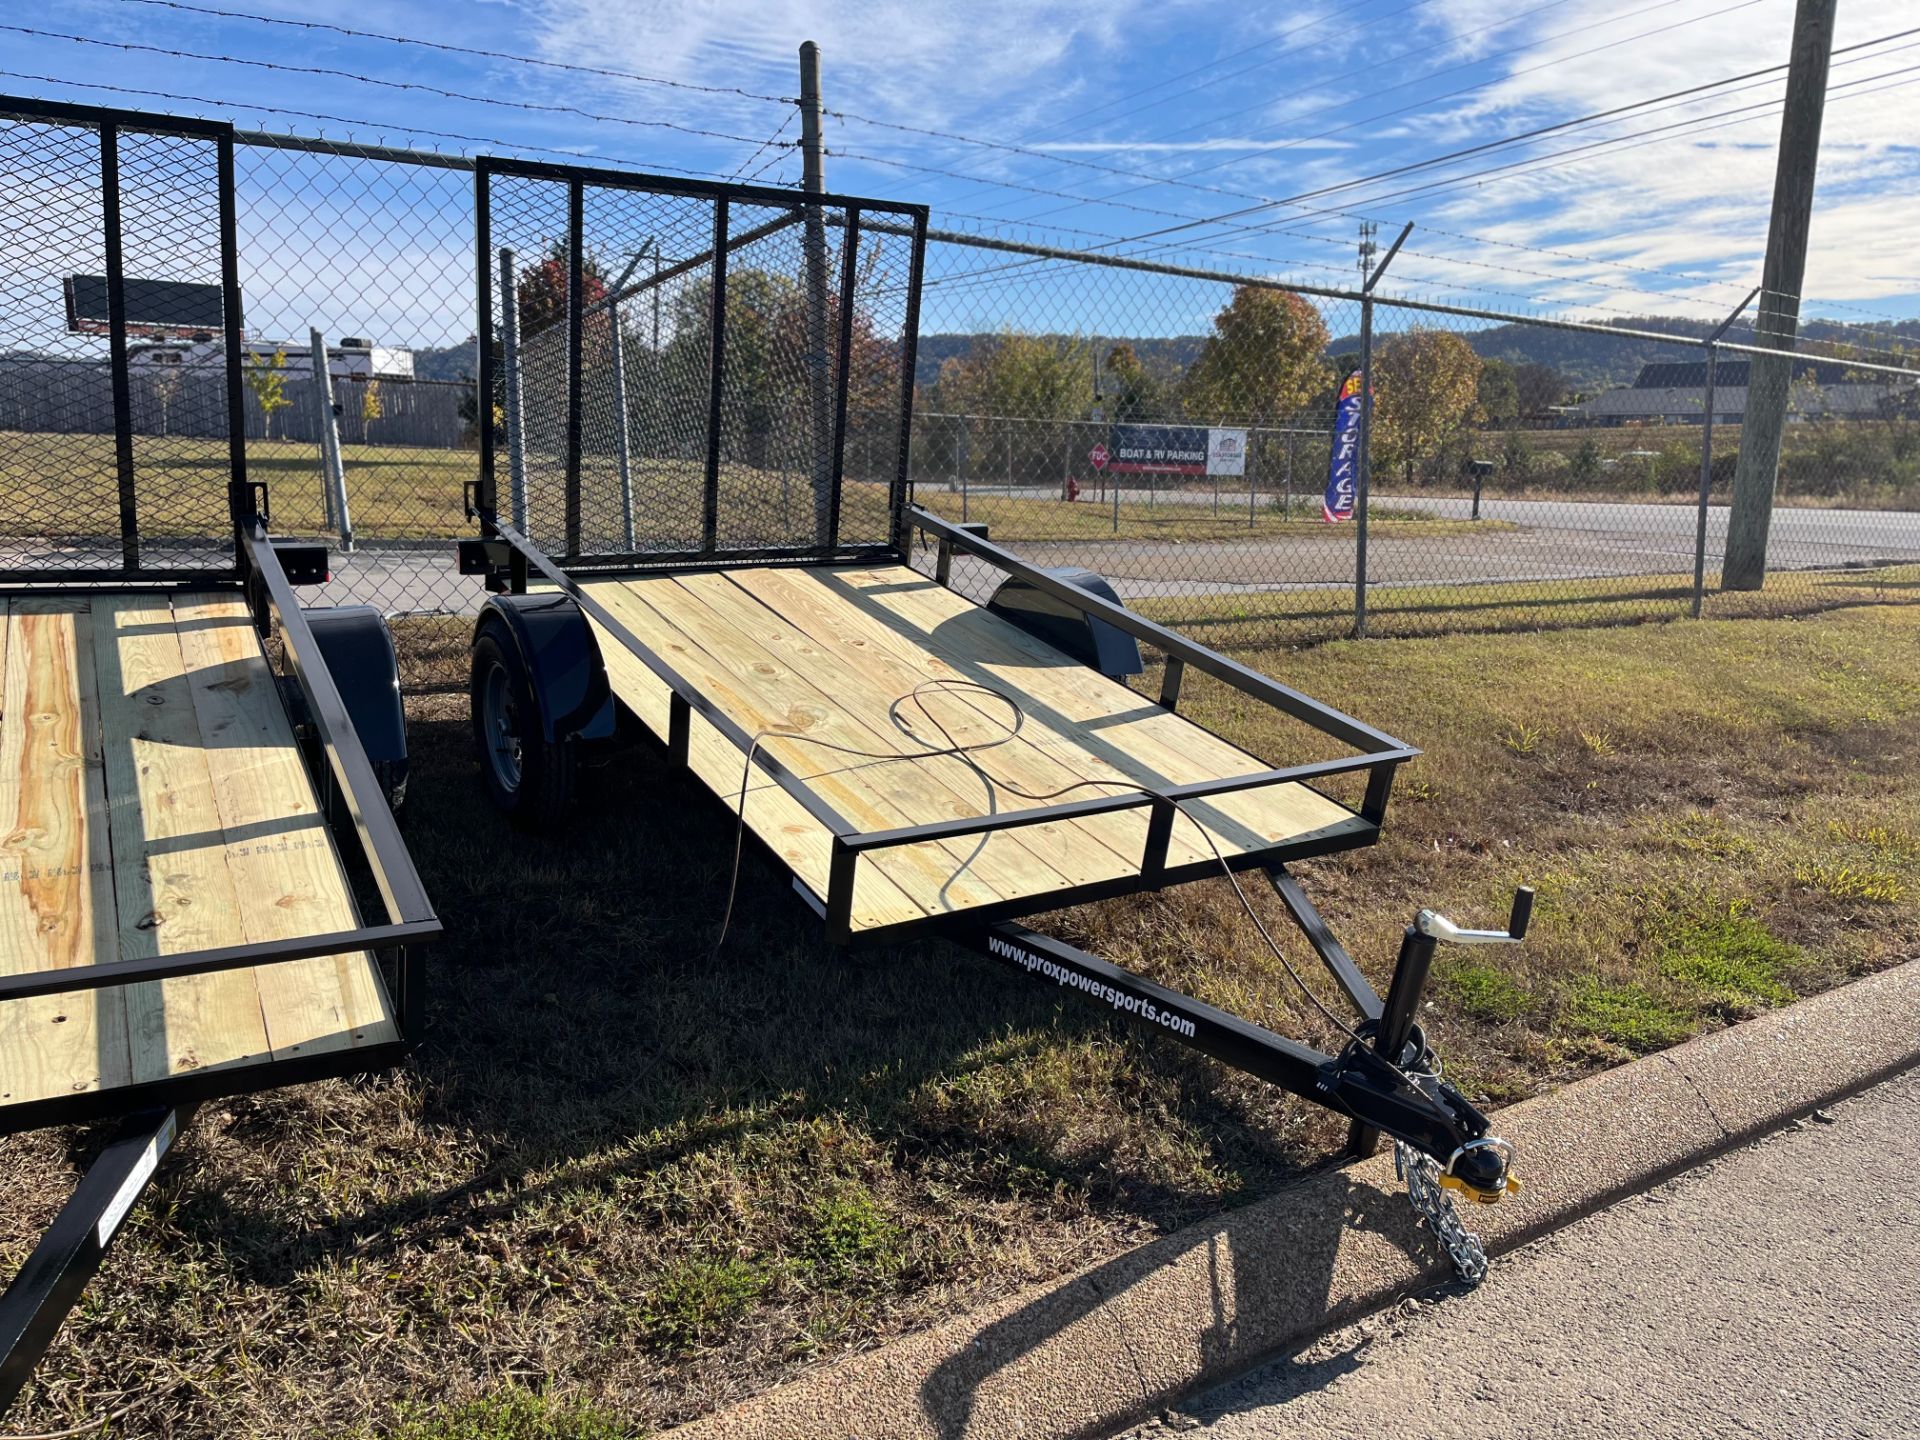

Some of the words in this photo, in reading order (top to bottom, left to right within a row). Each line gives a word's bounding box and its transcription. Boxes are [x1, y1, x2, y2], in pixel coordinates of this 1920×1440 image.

[1120, 448, 1144, 459] BOAT
[1146, 449, 1152, 459] &
[1154, 449, 1165, 459] RV
[1167, 450, 1205, 461] PARKING
[1335, 396, 1362, 510] STORAGE
[988, 936, 1196, 1038] www.proxpowersports.com
